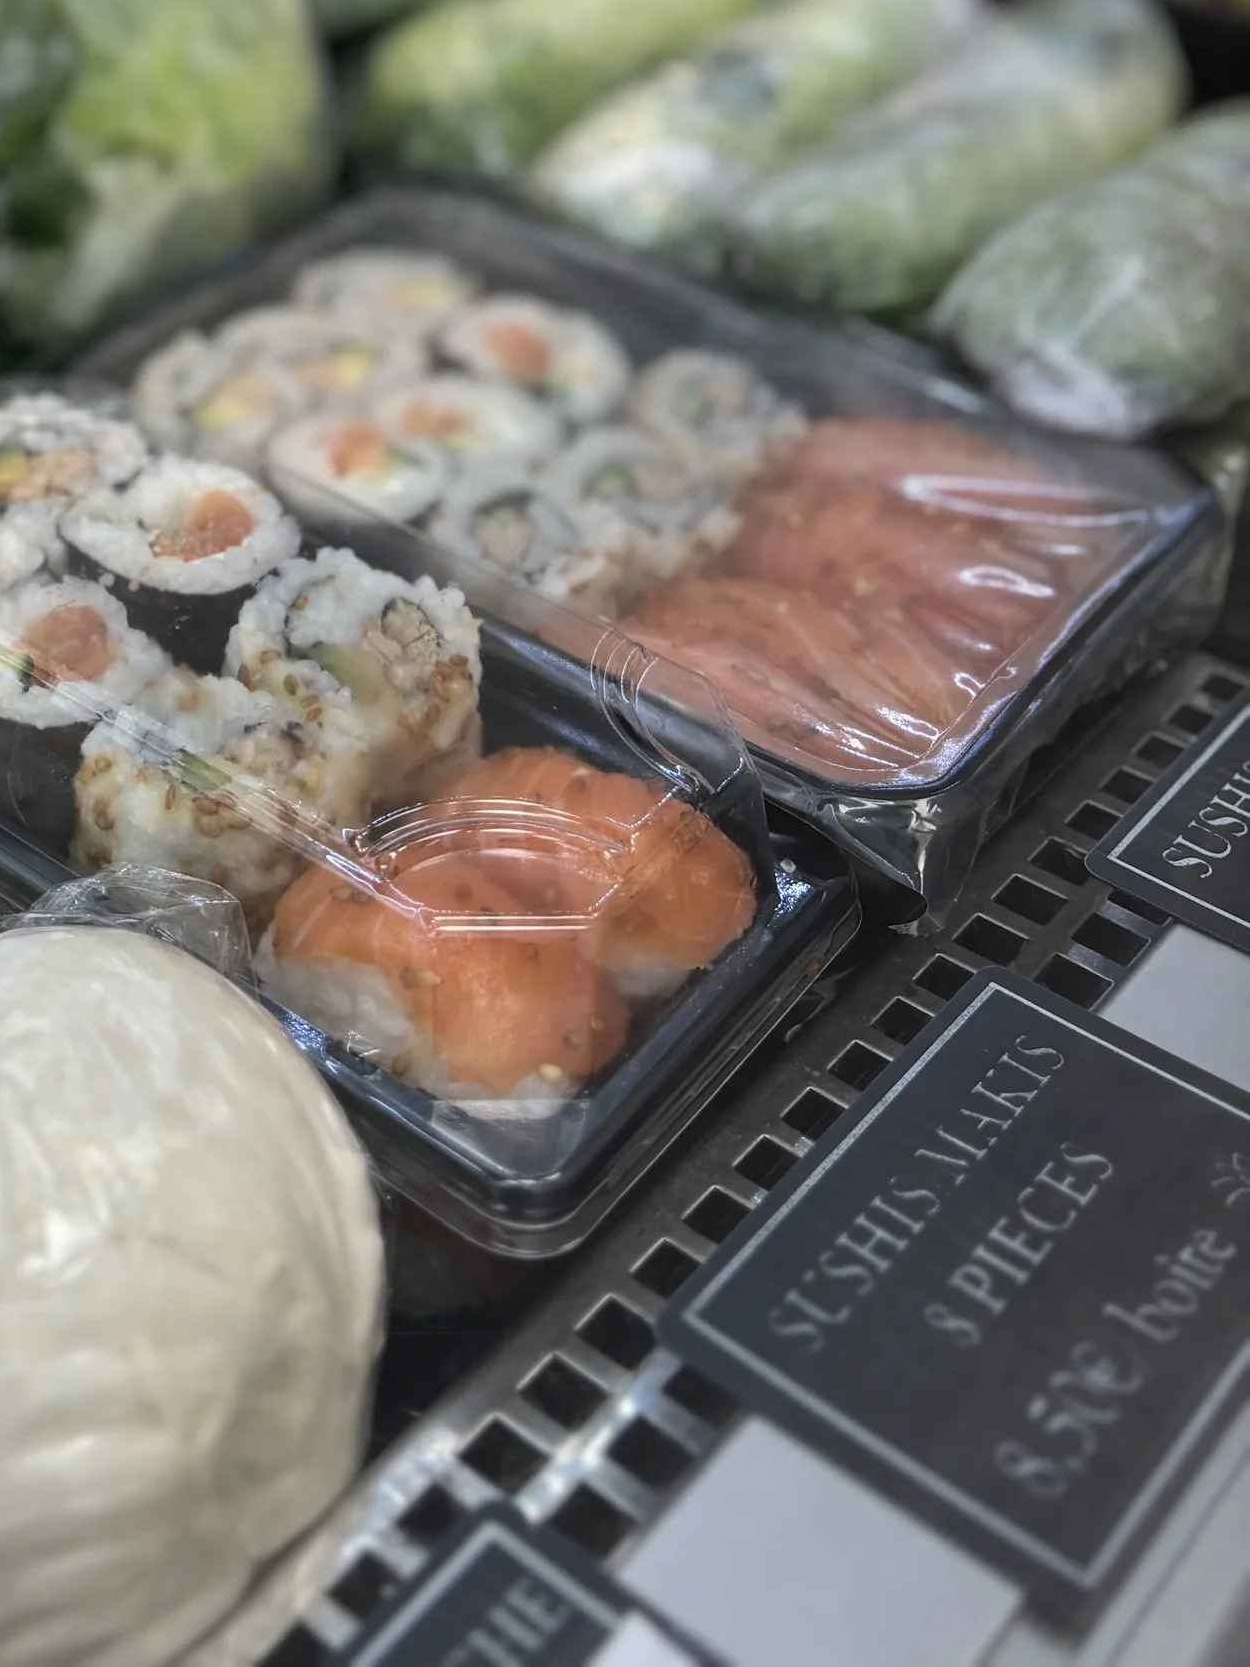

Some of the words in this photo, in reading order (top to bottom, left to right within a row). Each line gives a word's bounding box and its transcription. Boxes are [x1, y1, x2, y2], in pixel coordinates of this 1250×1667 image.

[768, 1176, 940, 1353] SUSHIS
[915, 1035, 1065, 1185] MAKIS
[948, 1141, 1113, 1315] PIECES
[923, 1302, 981, 1347] 8
